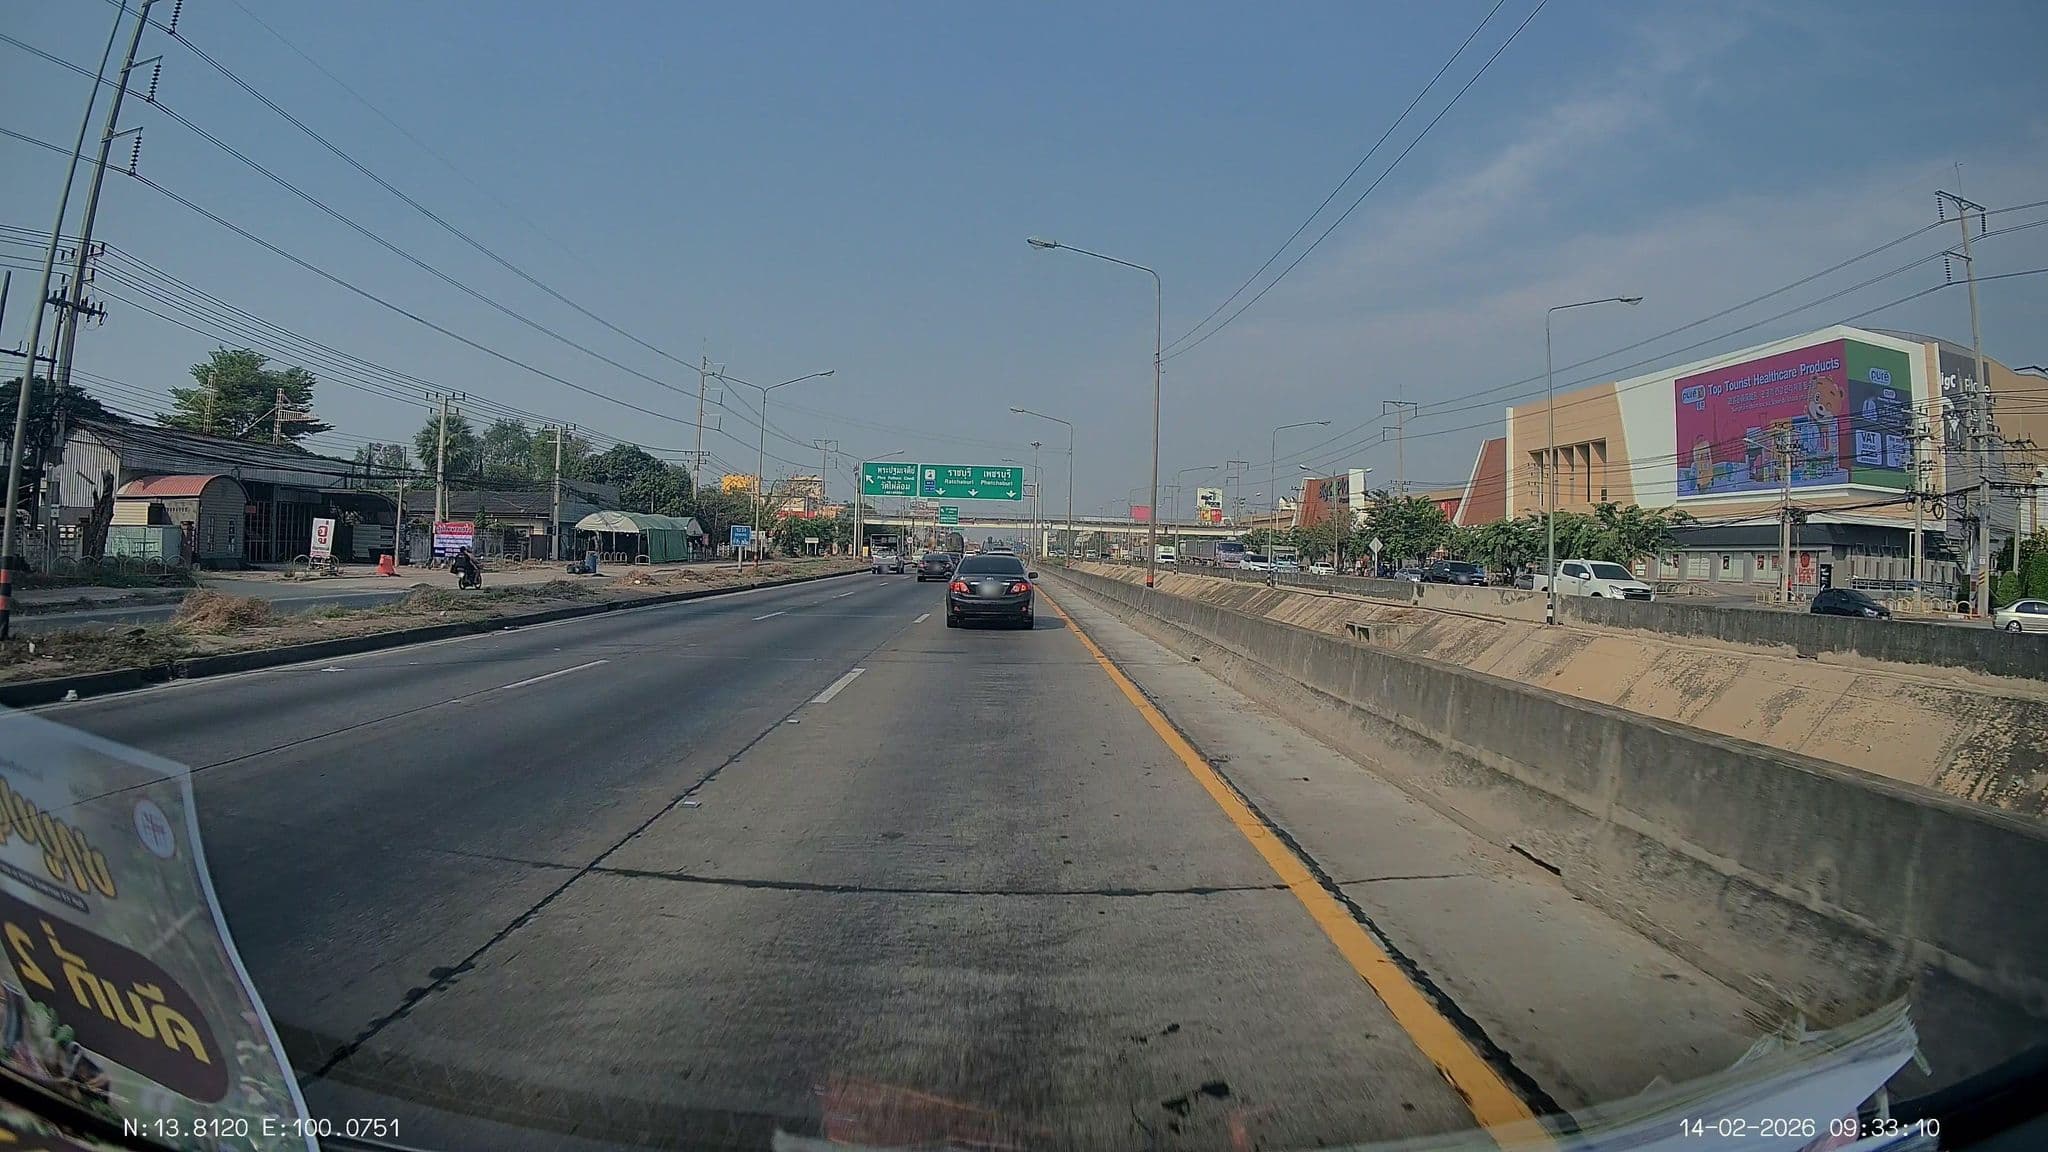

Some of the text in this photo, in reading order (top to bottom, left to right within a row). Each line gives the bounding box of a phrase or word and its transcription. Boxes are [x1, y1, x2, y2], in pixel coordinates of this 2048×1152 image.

[1708, 384, 1722, 396] Top
[1724, 378, 1752, 392] Tourist
[1753, 368, 1798, 386] Healthcare
[1799, 358, 1841, 375] Products
[1871, 370, 1890, 382] pure
[1941, 371, 1957, 391] igC
[1861, 432, 1876, 444] VAT
[948, 468, 1012, 481] ราชบุรี เพชรบุรี
